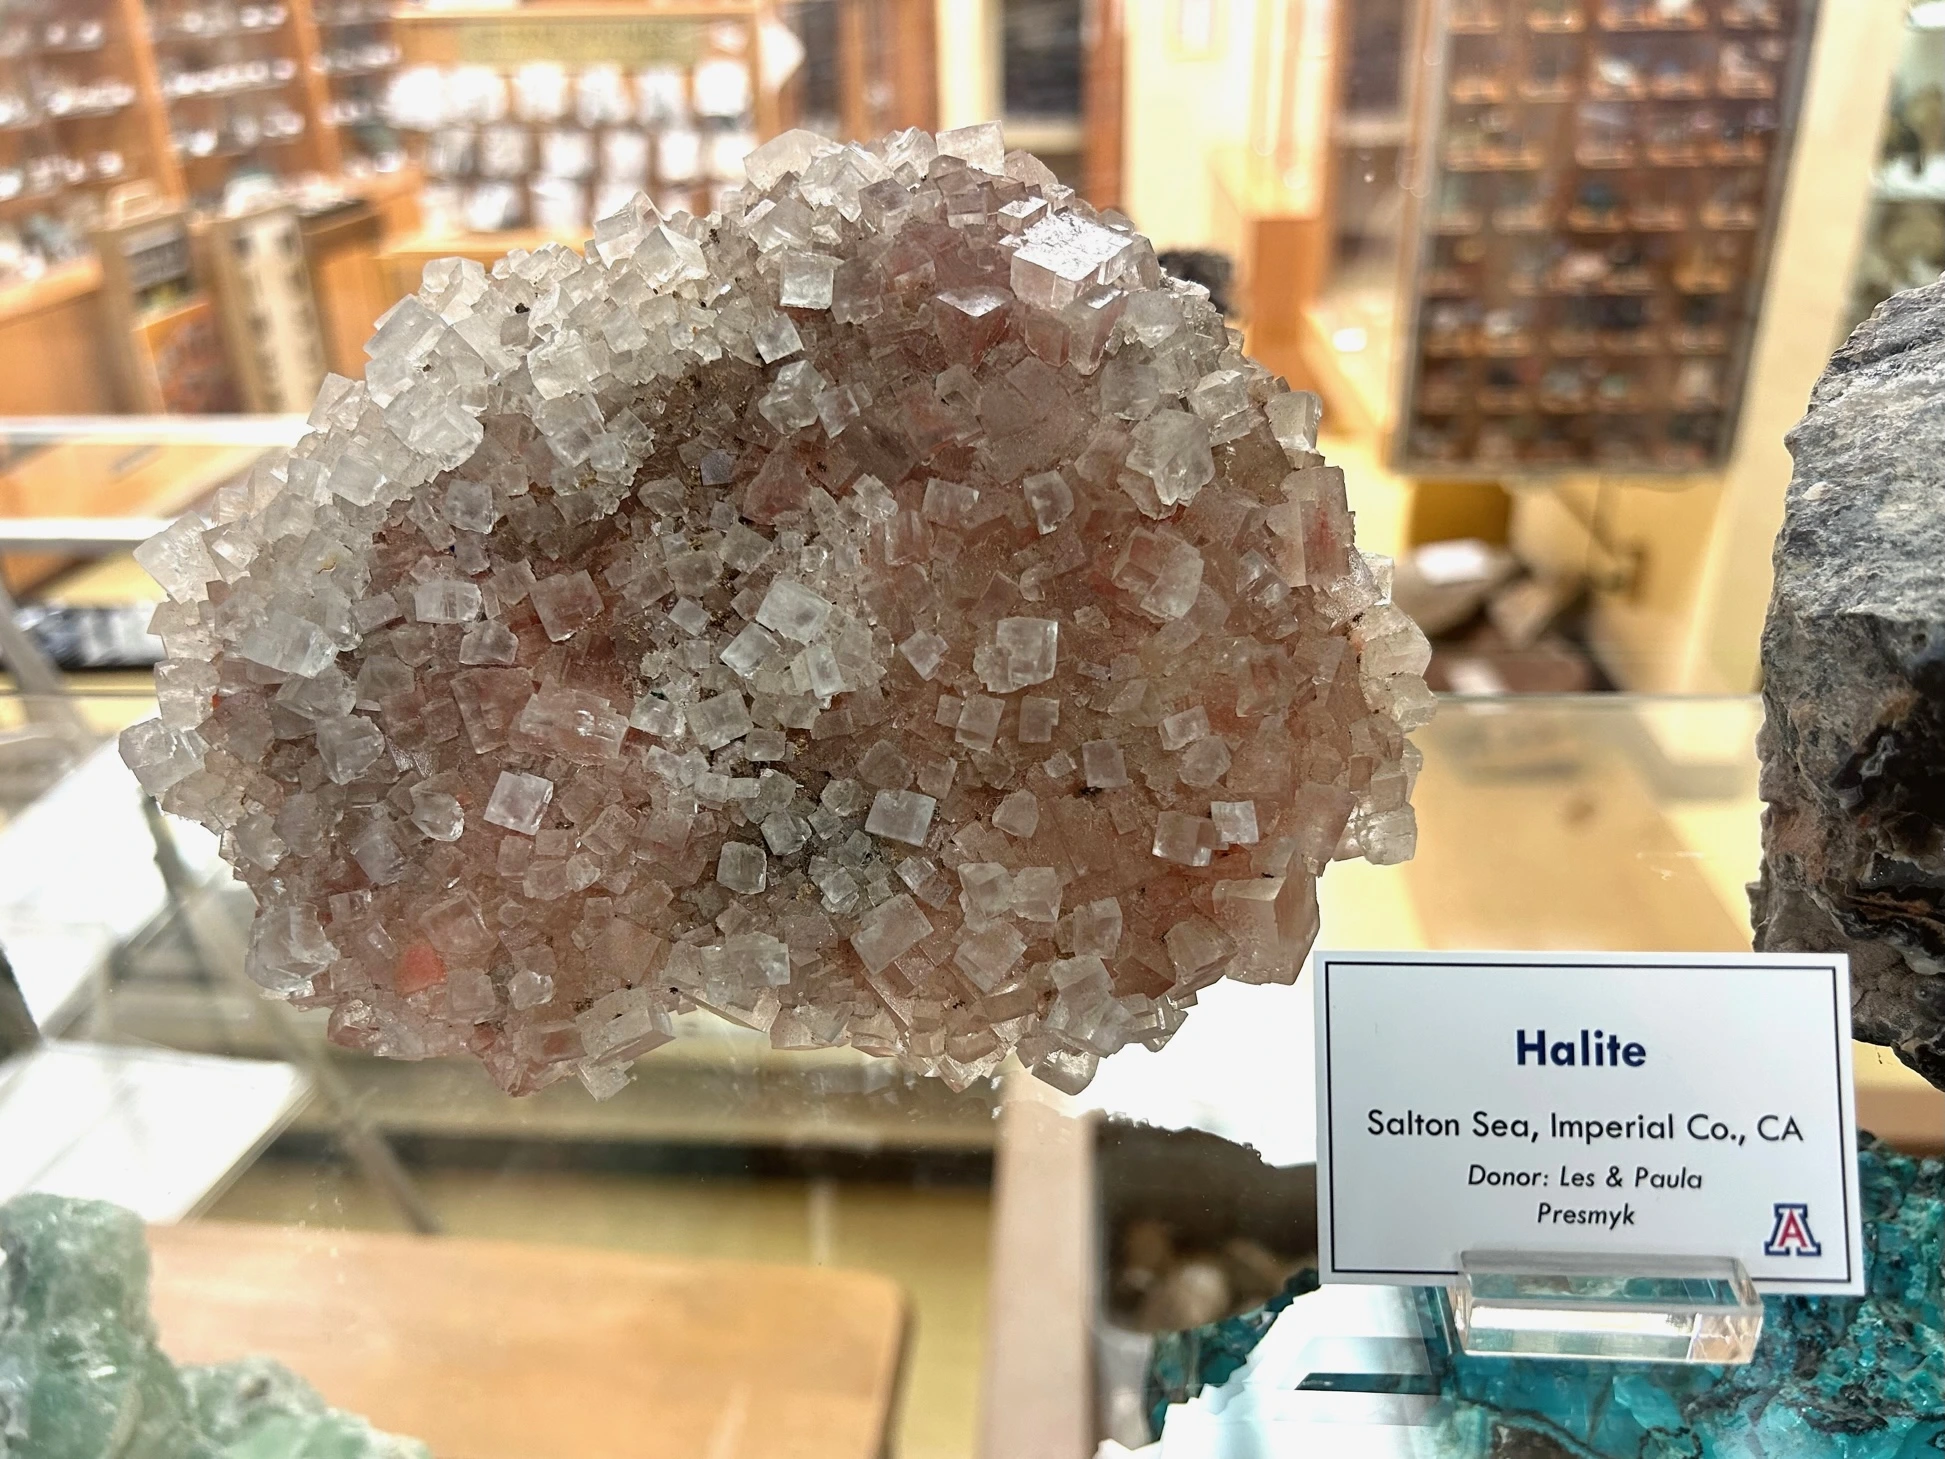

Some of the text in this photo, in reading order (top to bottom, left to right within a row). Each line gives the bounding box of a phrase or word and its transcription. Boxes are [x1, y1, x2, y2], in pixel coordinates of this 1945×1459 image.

[1516, 1029, 1647, 1068] Halite
[1367, 1108, 1804, 1147] Salton Sea, Imperial Co., CA
[1467, 1163, 1702, 1189] Donor: Les & Paula
[1537, 1201, 1635, 1231] Presmyk
[1764, 1203, 1822, 1257] A
